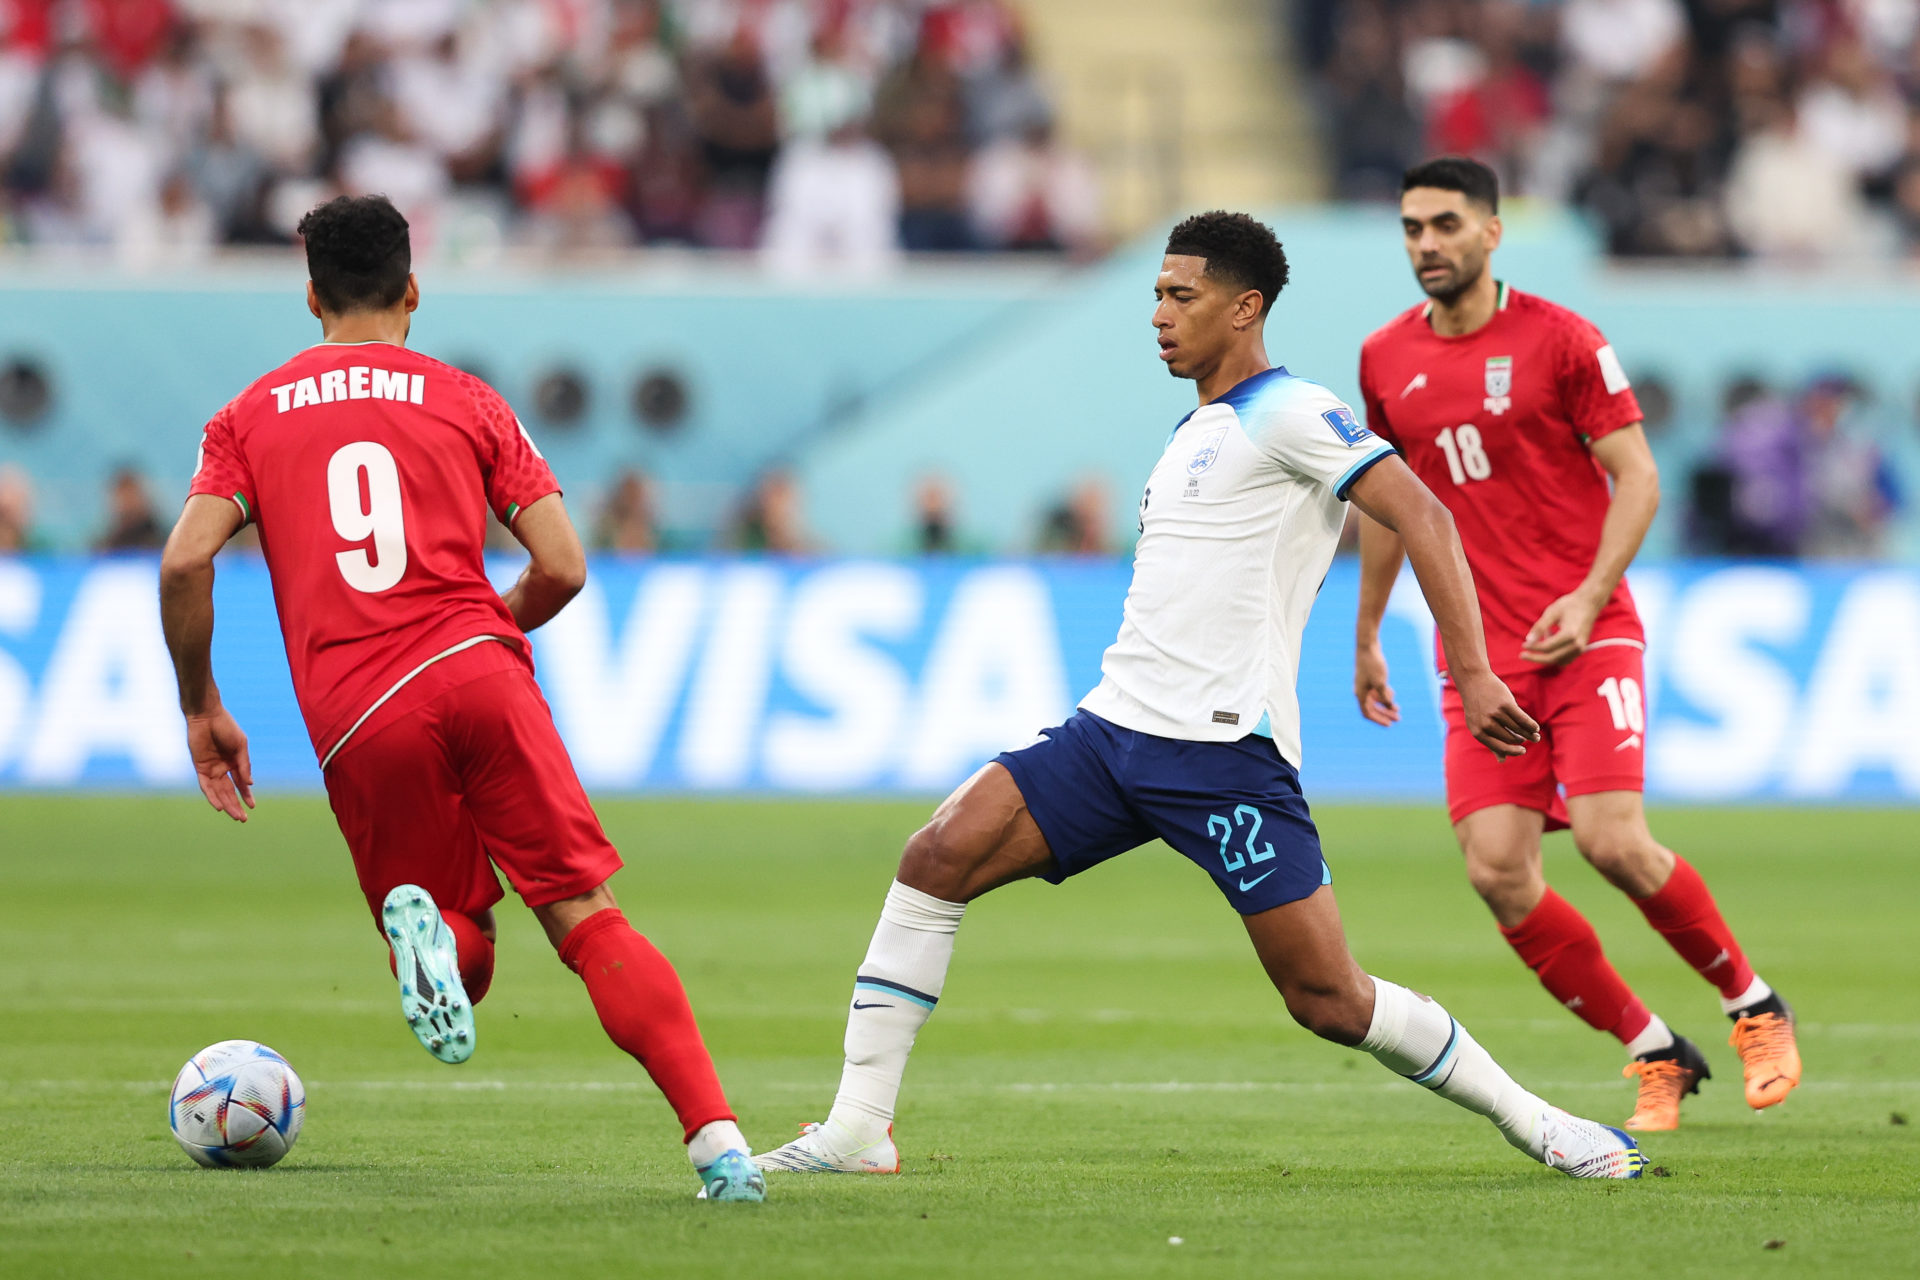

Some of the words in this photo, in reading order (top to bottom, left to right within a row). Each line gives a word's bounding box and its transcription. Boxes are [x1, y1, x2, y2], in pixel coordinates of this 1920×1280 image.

[271, 366, 425, 414] TAREMI
[1435, 423, 1492, 485] 18
[327, 440, 408, 593] 9
[490, 565, 1076, 788] VISA
[1597, 676, 1644, 733] 18
[1207, 804, 1276, 872] 22
